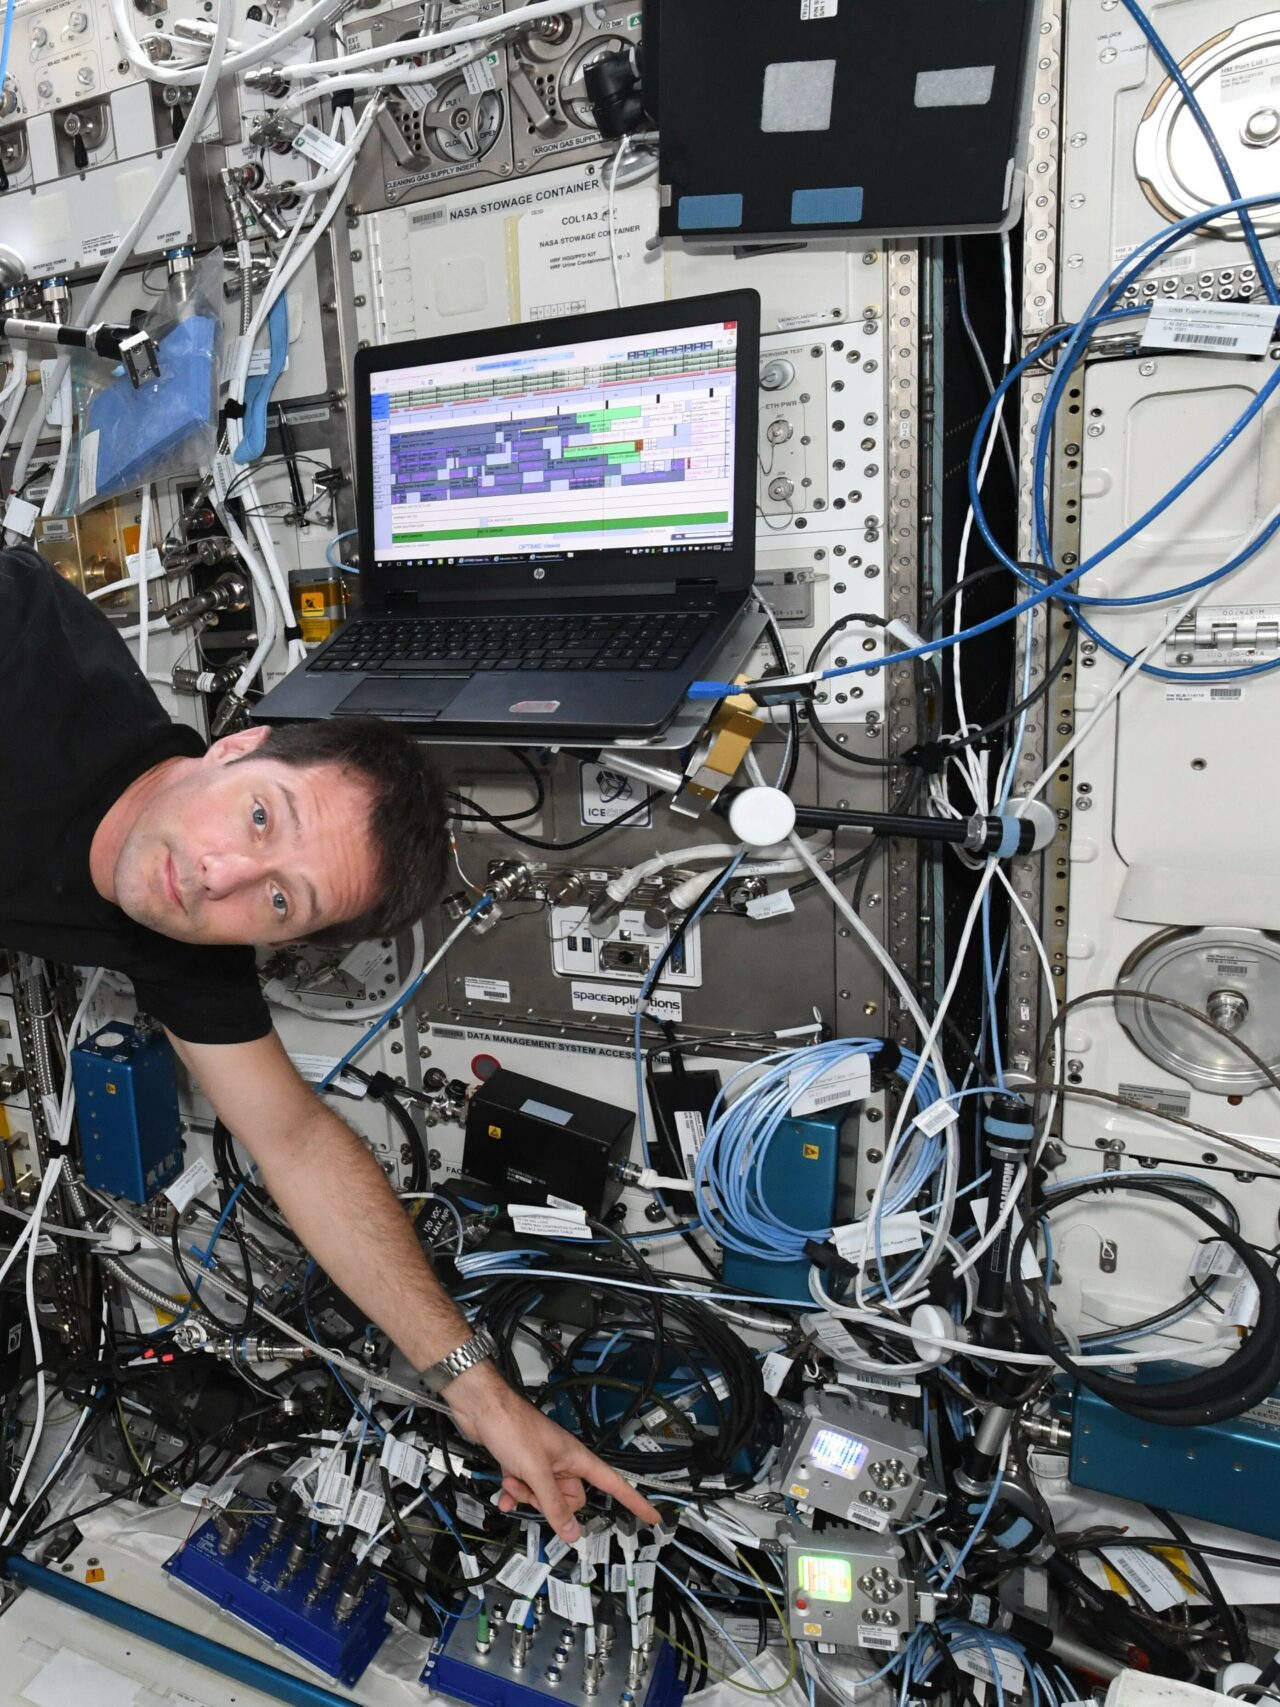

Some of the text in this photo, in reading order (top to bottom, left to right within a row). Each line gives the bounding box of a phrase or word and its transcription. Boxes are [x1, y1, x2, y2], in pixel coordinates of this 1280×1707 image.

[348, 36, 359, 45] EXT
[534, 134, 602, 155] ARGON GAS SUPPLY
[386, 162, 479, 189] CLEANING GAS SUPPLY INSERT
[450, 179, 600, 221] NASA STOWAGE CONTAINER
[539, 238, 559, 248] NASA
[560, 232, 596, 245] STOWAGE
[778, 400, 798, 408] PWR
[534, 568, 545, 579] hp
[467, 1031, 490, 1042] DATA
[491, 1034, 556, 1050] MANAGEMENT
[558, 1041, 597, 1055] SYSTEM
[598, 1047, 638, 1060] ACCESS
[424, 1206, 442, 1233] 120 VDC
[431, 1221, 443, 1236] MAX
